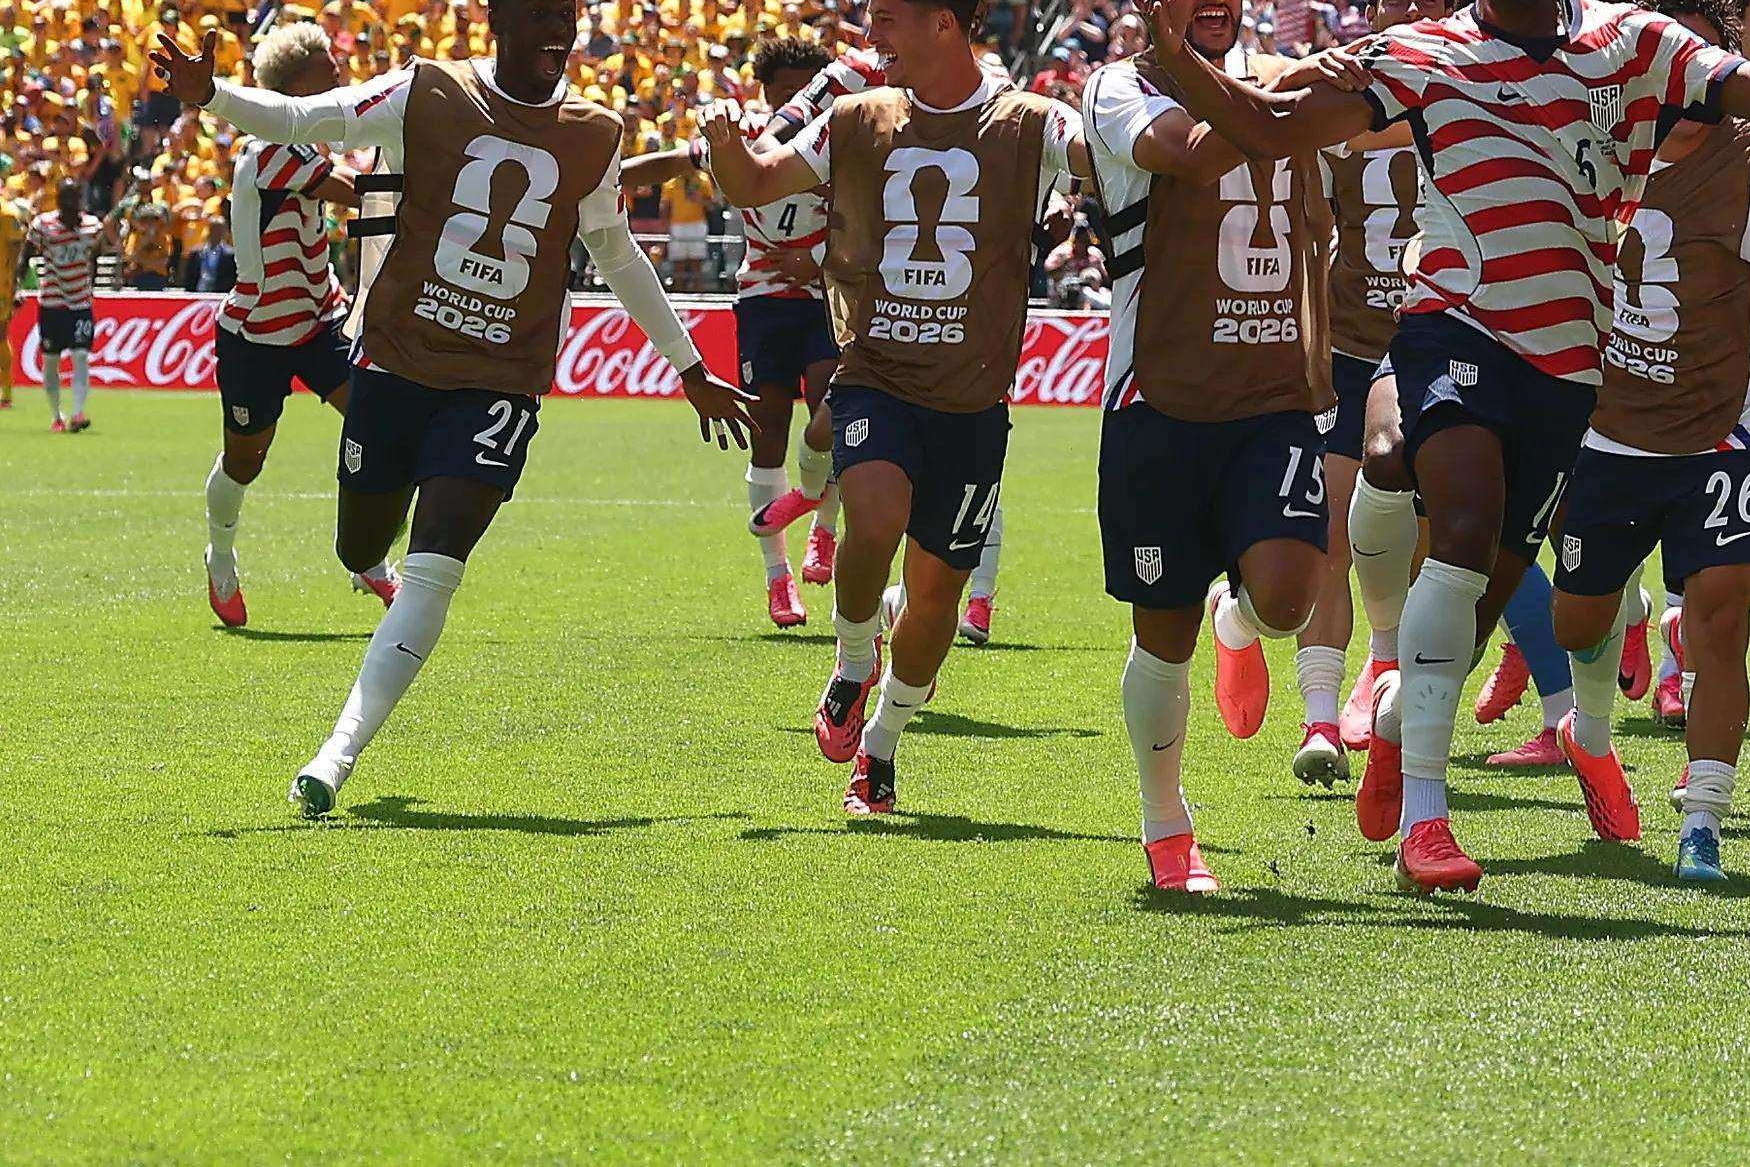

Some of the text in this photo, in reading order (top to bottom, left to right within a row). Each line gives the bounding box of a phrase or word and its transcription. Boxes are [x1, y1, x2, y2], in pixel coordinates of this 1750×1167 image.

[1590, 86, 1618, 107] USA
[777, 203, 798, 237] 4
[459, 258, 504, 285] FIFA
[904, 268, 947, 286] FIFA
[1246, 257, 1280, 276] FIFA
[1365, 276, 1406, 288] WOR
[422, 281, 518, 321] WORLD CUP
[875, 299, 968, 321] WORLD CUP
[1216, 298, 1293, 315] WORLD CUP
[1366, 290, 1404, 309] 20
[414, 297, 511, 344] 2026
[868, 316, 965, 344] 2026
[1213, 317, 1298, 344] 2026
[1608, 333, 1679, 363] ORLD CUP
[1604, 345, 1675, 384] 026
[473, 399, 530, 455] 21
[1278, 445, 1324, 505] 15
[952, 482, 999, 534] 14
[1136, 547, 1160, 564] USA
